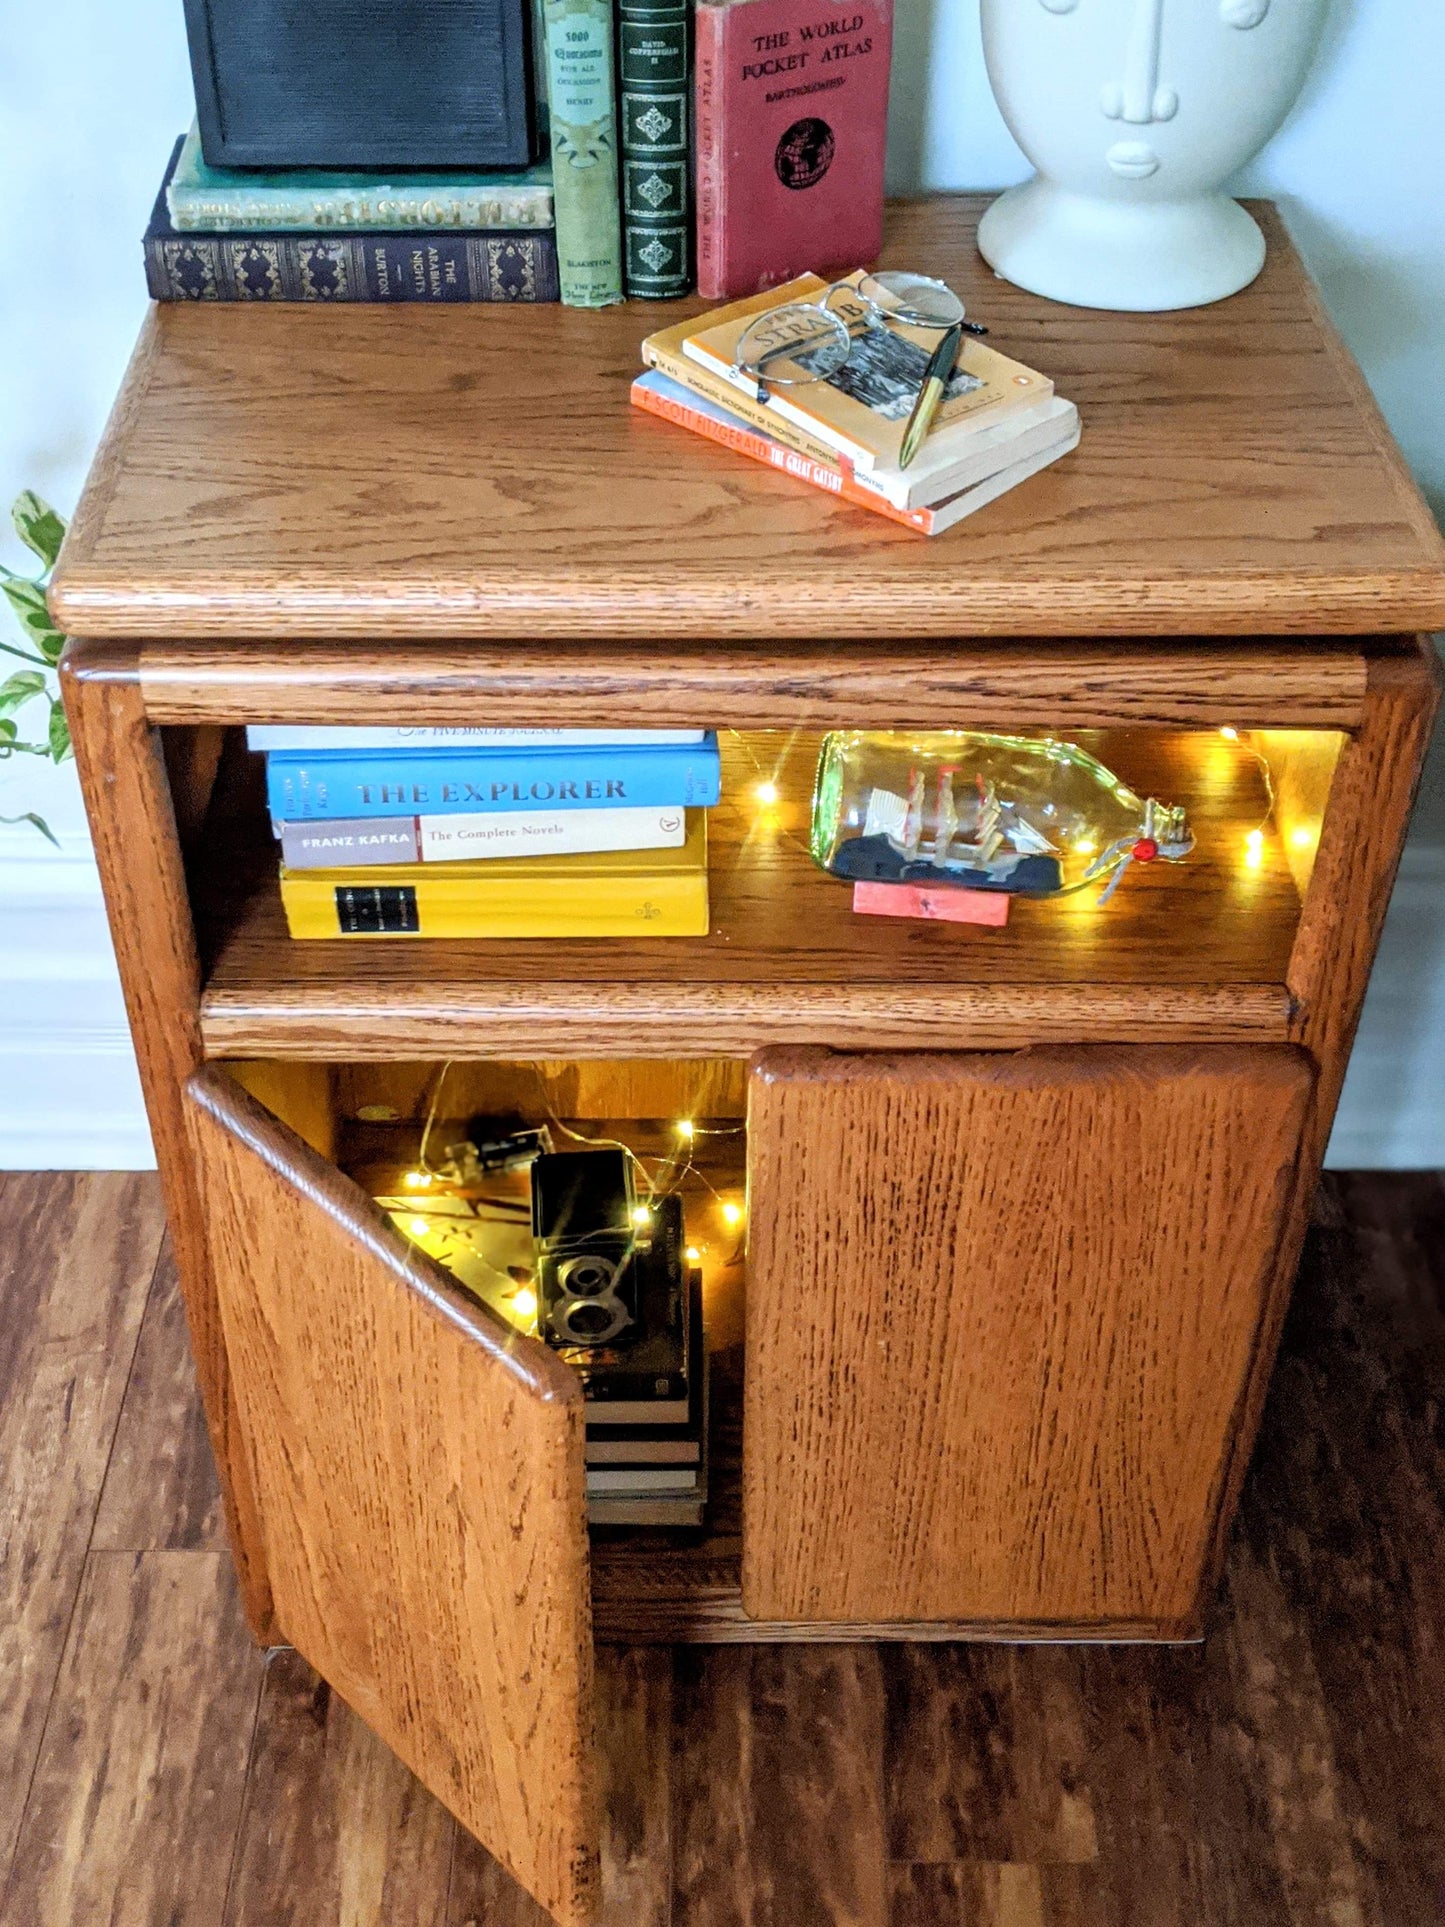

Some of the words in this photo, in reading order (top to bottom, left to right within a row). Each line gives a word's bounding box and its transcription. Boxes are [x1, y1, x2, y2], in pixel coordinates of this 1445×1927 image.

[751, 31, 789, 52] THE
[800, 15, 864, 41] WORLD
[742, 52, 809, 81] POCKET
[820, 38, 872, 63] ATLAS
[703, 60, 712, 107] ATLAS
[314, 200, 462, 226] FORSTER
[703, 176, 712, 225] WORLD
[703, 235, 712, 259] THE
[375, 248, 390, 295] BURTON
[412, 250, 426, 294] NIGHTS
[428, 246, 441, 296] ARABIAN
[444, 260, 457, 284] THE
[655, 396, 692, 424] SCOTT
[697, 415, 768, 457] FITZGERALD
[771, 447, 785, 467] THE
[786, 454, 812, 479] GREAT
[813, 466, 844, 493] GATSBY
[357, 784, 430, 804] THE
[442, 779, 628, 802] EXPLORER
[302, 836, 354, 848] FRANZ
[359, 833, 410, 845] KAFKA
[429, 830, 452, 841] The
[457, 826, 516, 840] Complete
[522, 824, 564, 836] Novels
